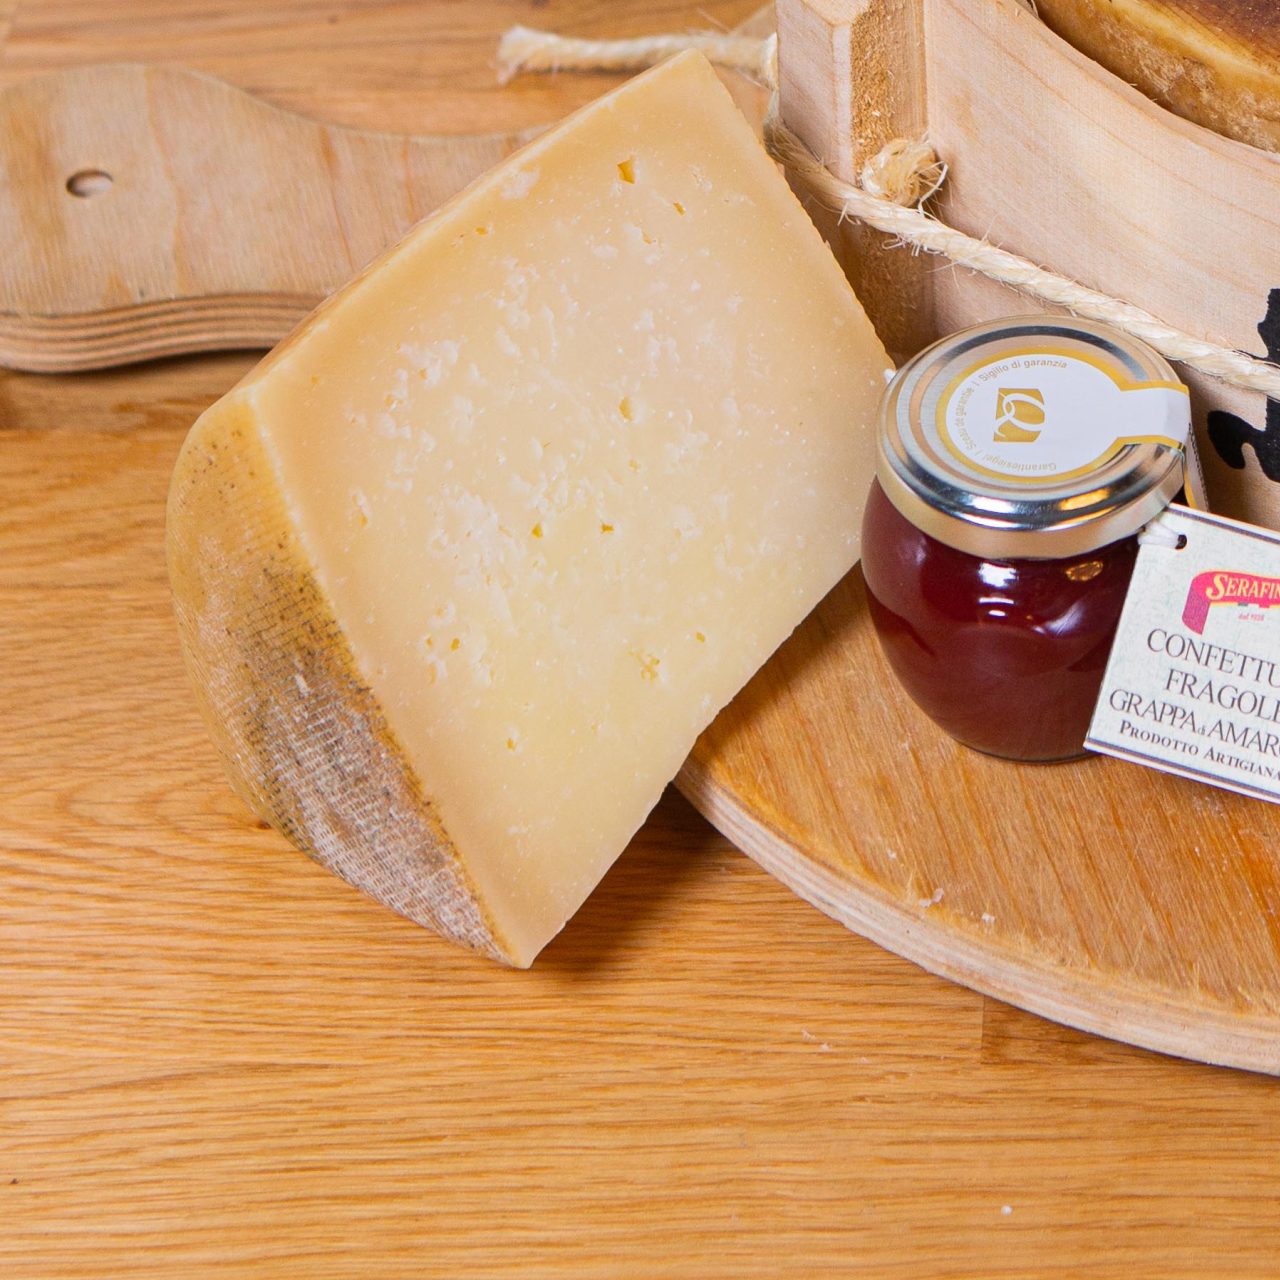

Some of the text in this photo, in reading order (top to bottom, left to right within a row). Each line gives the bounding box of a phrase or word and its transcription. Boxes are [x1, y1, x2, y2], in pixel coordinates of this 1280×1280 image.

[978, 359, 1068, 382] Sigillo di garanzia
[1109, 688, 1197, 734] GRAPPA
[1119, 720, 1198, 756] PRODOTTO
